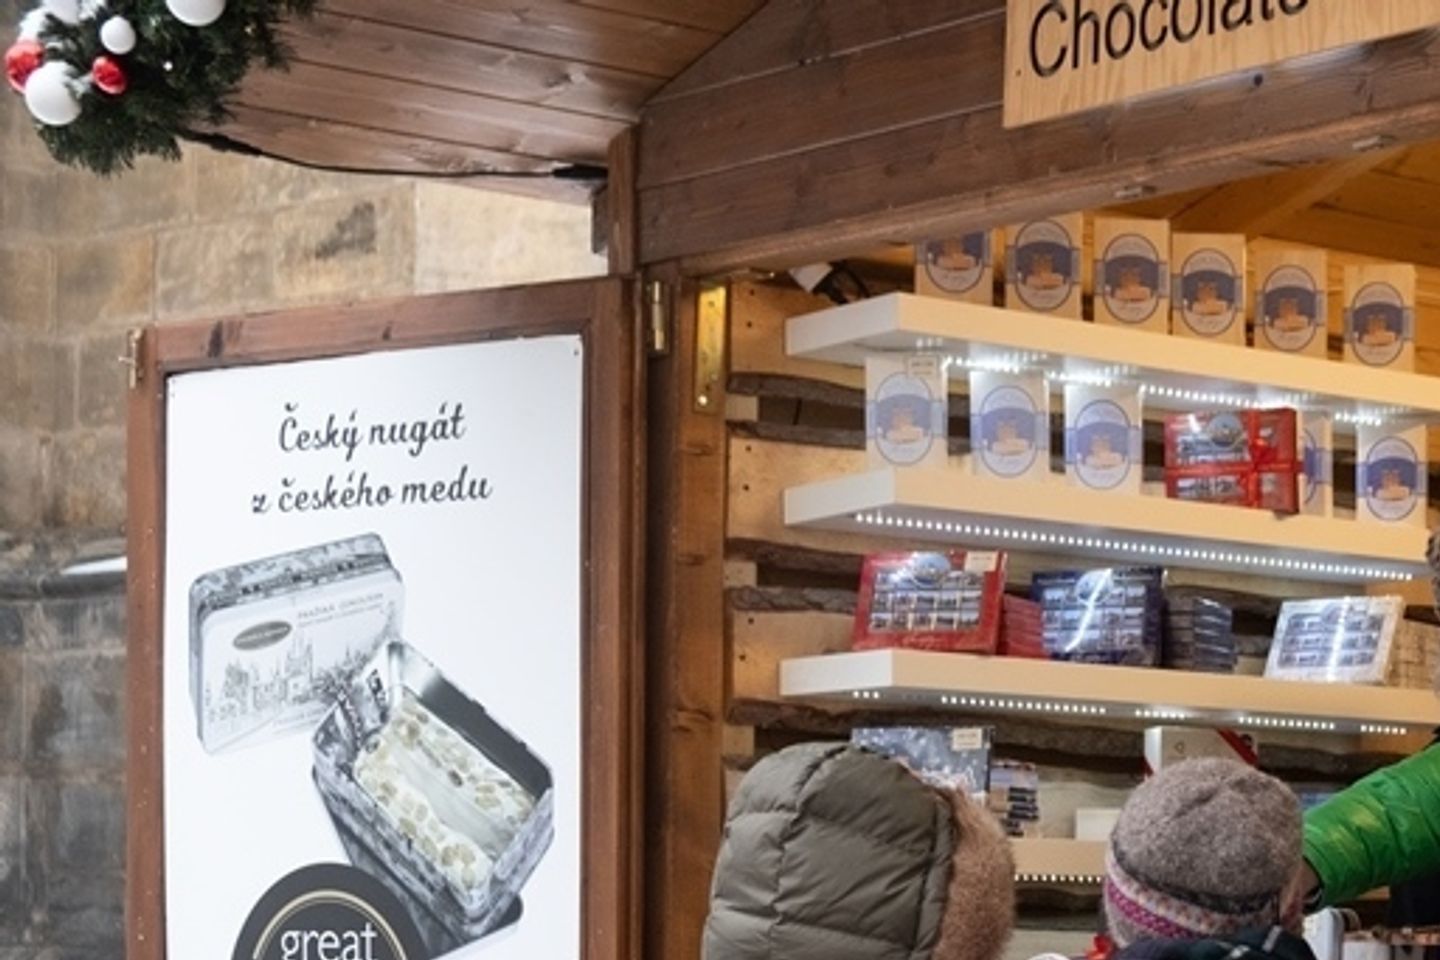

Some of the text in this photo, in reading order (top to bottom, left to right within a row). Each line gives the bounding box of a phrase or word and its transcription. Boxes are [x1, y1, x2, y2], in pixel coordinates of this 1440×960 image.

[1029, 0, 1307, 77] Chocoa
[279, 401, 466, 461] Český nugát
[252, 465, 493, 513] z českého medu
